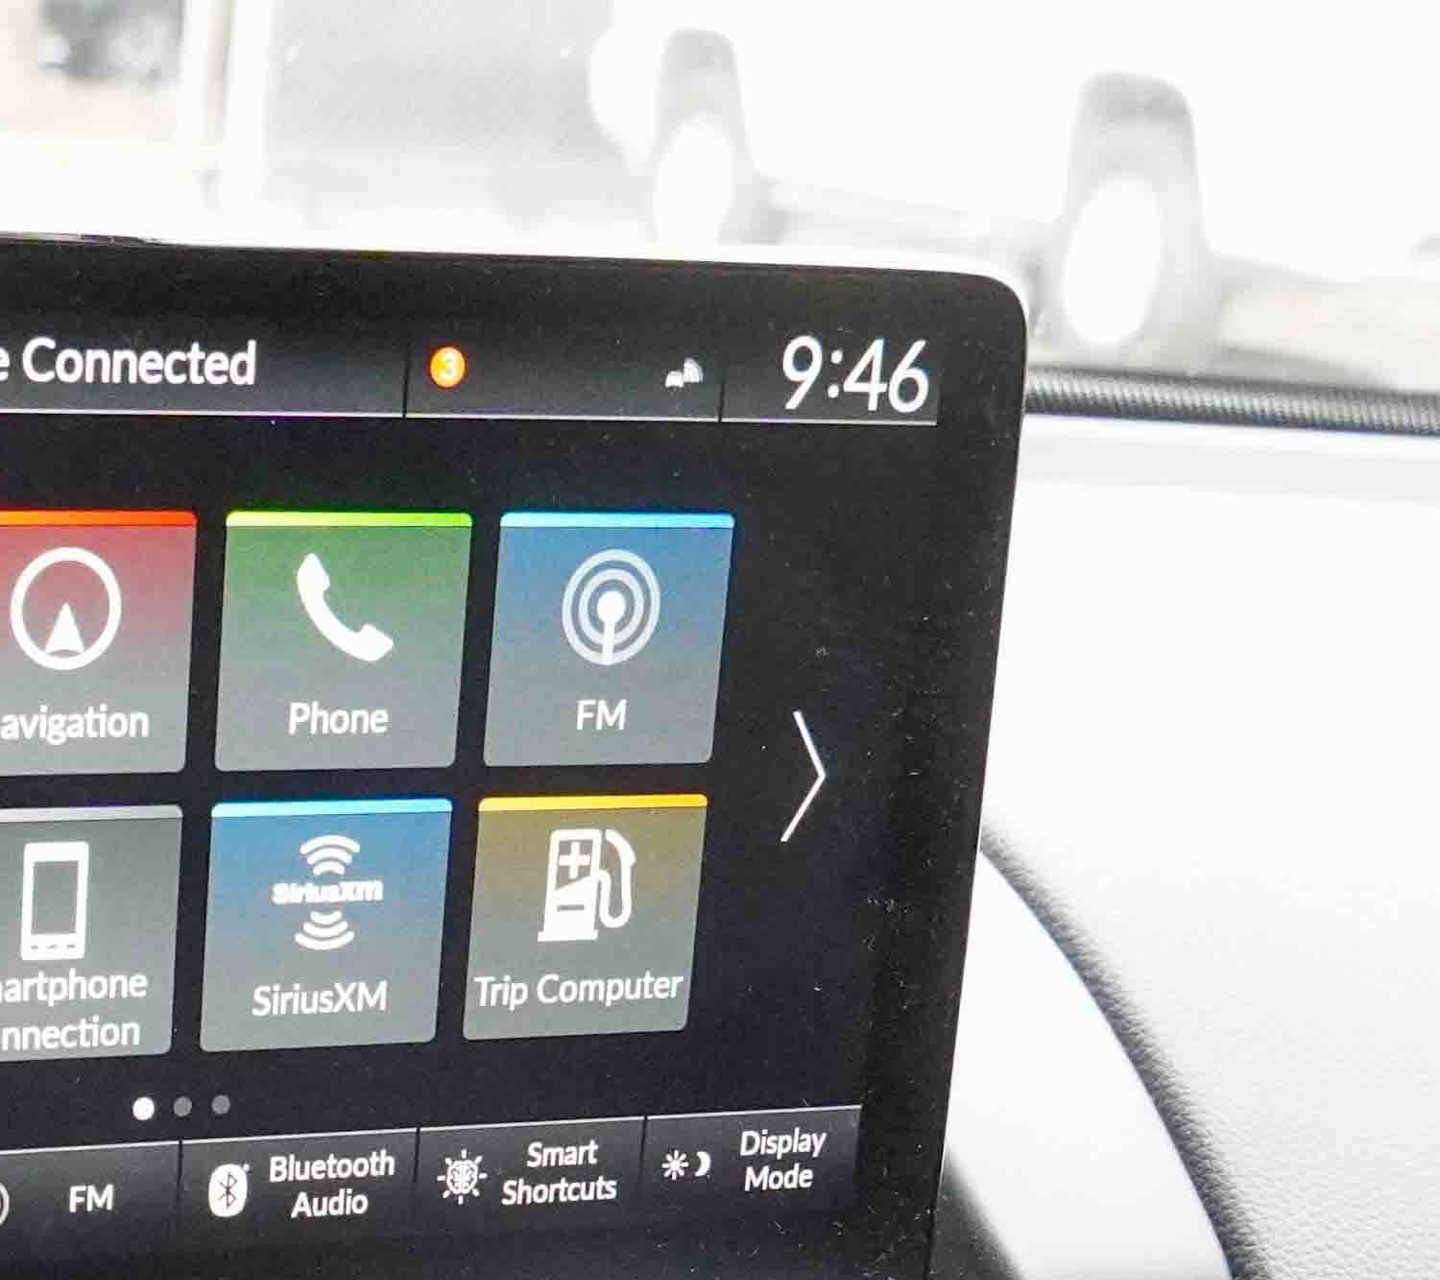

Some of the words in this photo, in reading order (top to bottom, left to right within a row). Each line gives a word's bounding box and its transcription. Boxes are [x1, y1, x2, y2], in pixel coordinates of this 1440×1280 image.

[22, 337, 256, 385] Connected
[782, 335, 929, 413] 9:46
[288, 702, 389, 736] Phone
[576, 700, 627, 731] FM
[252, 981, 388, 1017] SiriusXM
[475, 975, 526, 1009] Trip
[537, 971, 683, 1007] Computer
[527, 1140, 598, 1169] Smart
[740, 1128, 826, 1160] Display
[269, 1151, 395, 1184] Bluetooth
[744, 1165, 813, 1192] Mode
[68, 1185, 114, 1213] FM
[292, 1190, 368, 1219] Audio
[502, 1174, 617, 1207] Shortcuts
